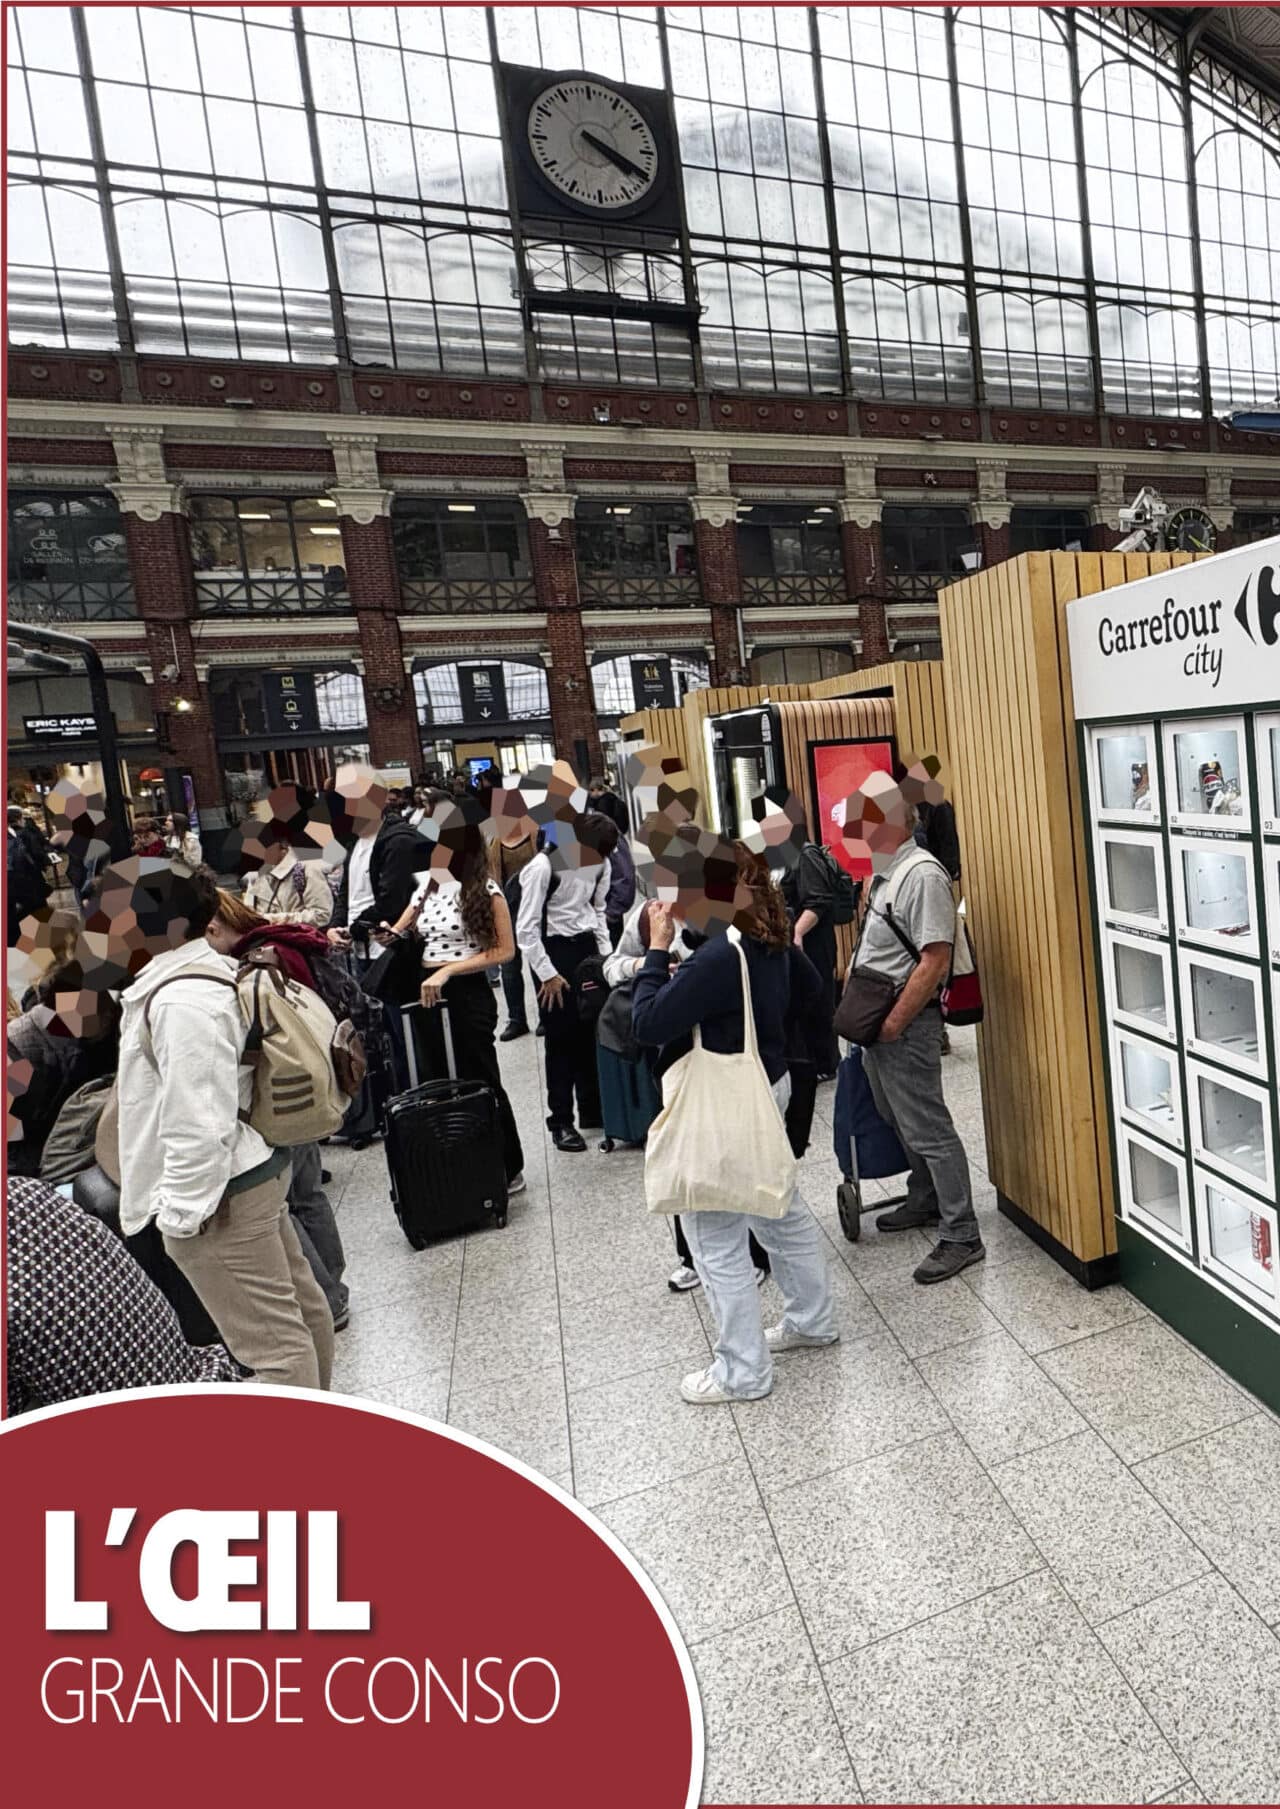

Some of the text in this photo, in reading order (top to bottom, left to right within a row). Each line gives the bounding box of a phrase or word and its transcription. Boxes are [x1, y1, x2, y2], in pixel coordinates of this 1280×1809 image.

[1098, 598, 1222, 657] Carrefour
[1183, 643, 1223, 688] city
[26, 717, 96, 728] ERIC KAYS
[1264, 820, 1273, 830] 03
